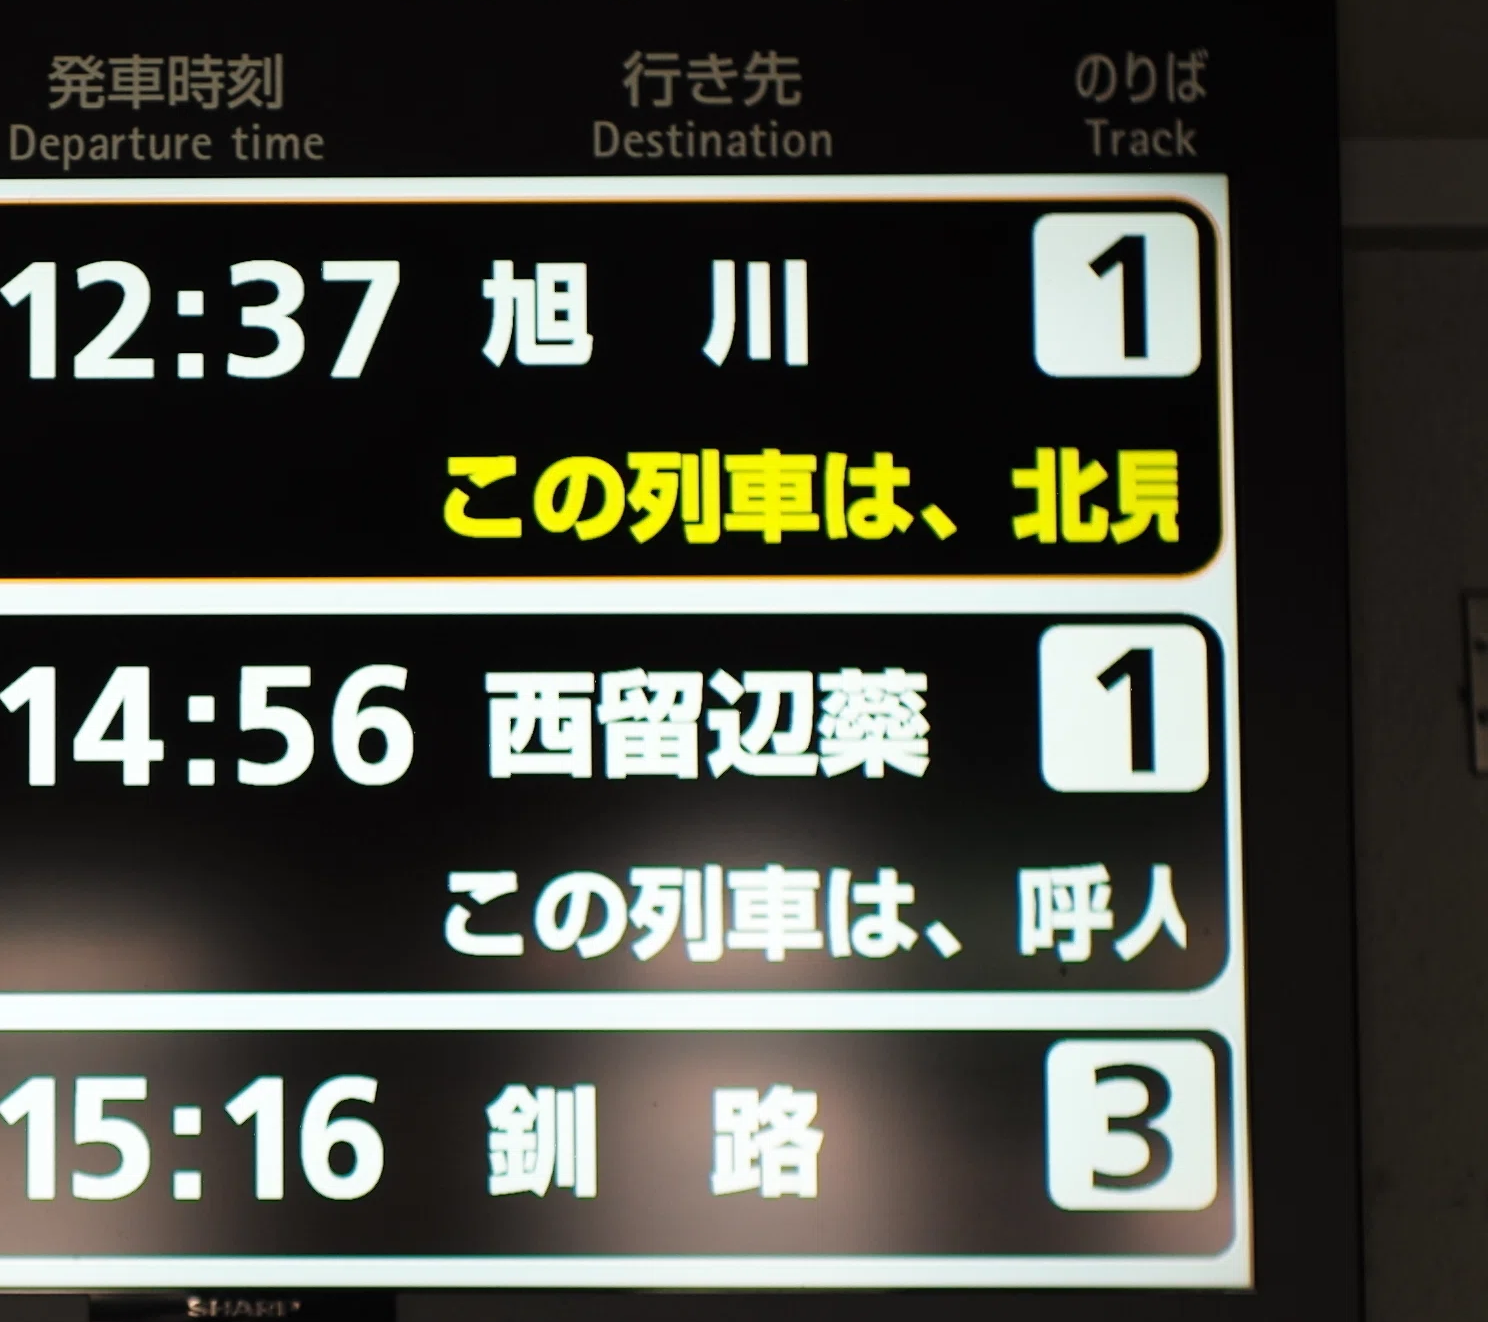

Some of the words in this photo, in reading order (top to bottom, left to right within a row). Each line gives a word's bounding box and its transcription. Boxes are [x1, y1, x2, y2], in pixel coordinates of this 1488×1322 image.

[47, 52, 284, 111] 発車時刻
[622, 49, 803, 109] 行き先
[1074, 48, 1210, 105] のりば
[9, 122, 213, 171] Departure
[230, 123, 325, 162] time
[592, 119, 833, 159] Destination
[1084, 117, 1198, 157] Track
[0, 259, 400, 379] 12:37
[1088, 234, 1149, 360] 1
[1096, 648, 1156, 774] 1
[1092, 1063, 1174, 1191] 3
